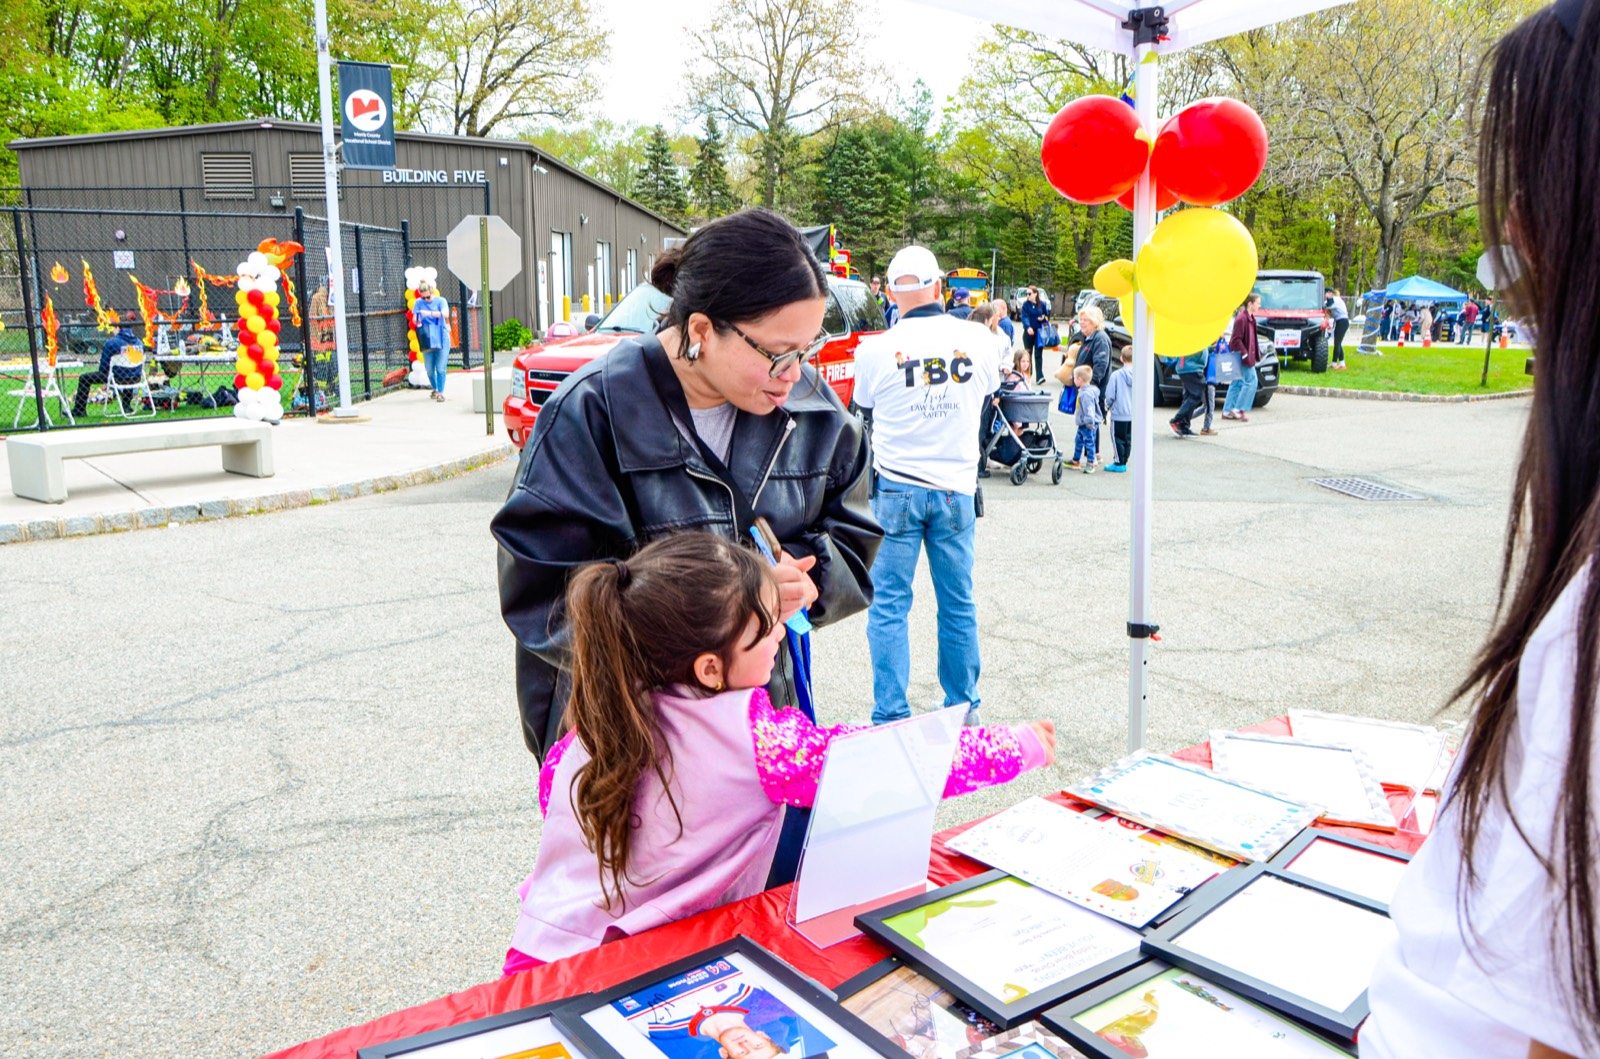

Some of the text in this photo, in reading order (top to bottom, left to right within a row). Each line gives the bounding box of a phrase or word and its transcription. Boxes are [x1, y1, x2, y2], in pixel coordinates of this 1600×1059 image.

[382, 170, 486, 183] BUILDING FIVE
[826, 363, 846, 382] FIRE
[897, 356, 973, 388] TBC
[936, 402, 961, 410] PUBLIC
[922, 410, 948, 419] SAFETY
[705, 960, 731, 976] 84
